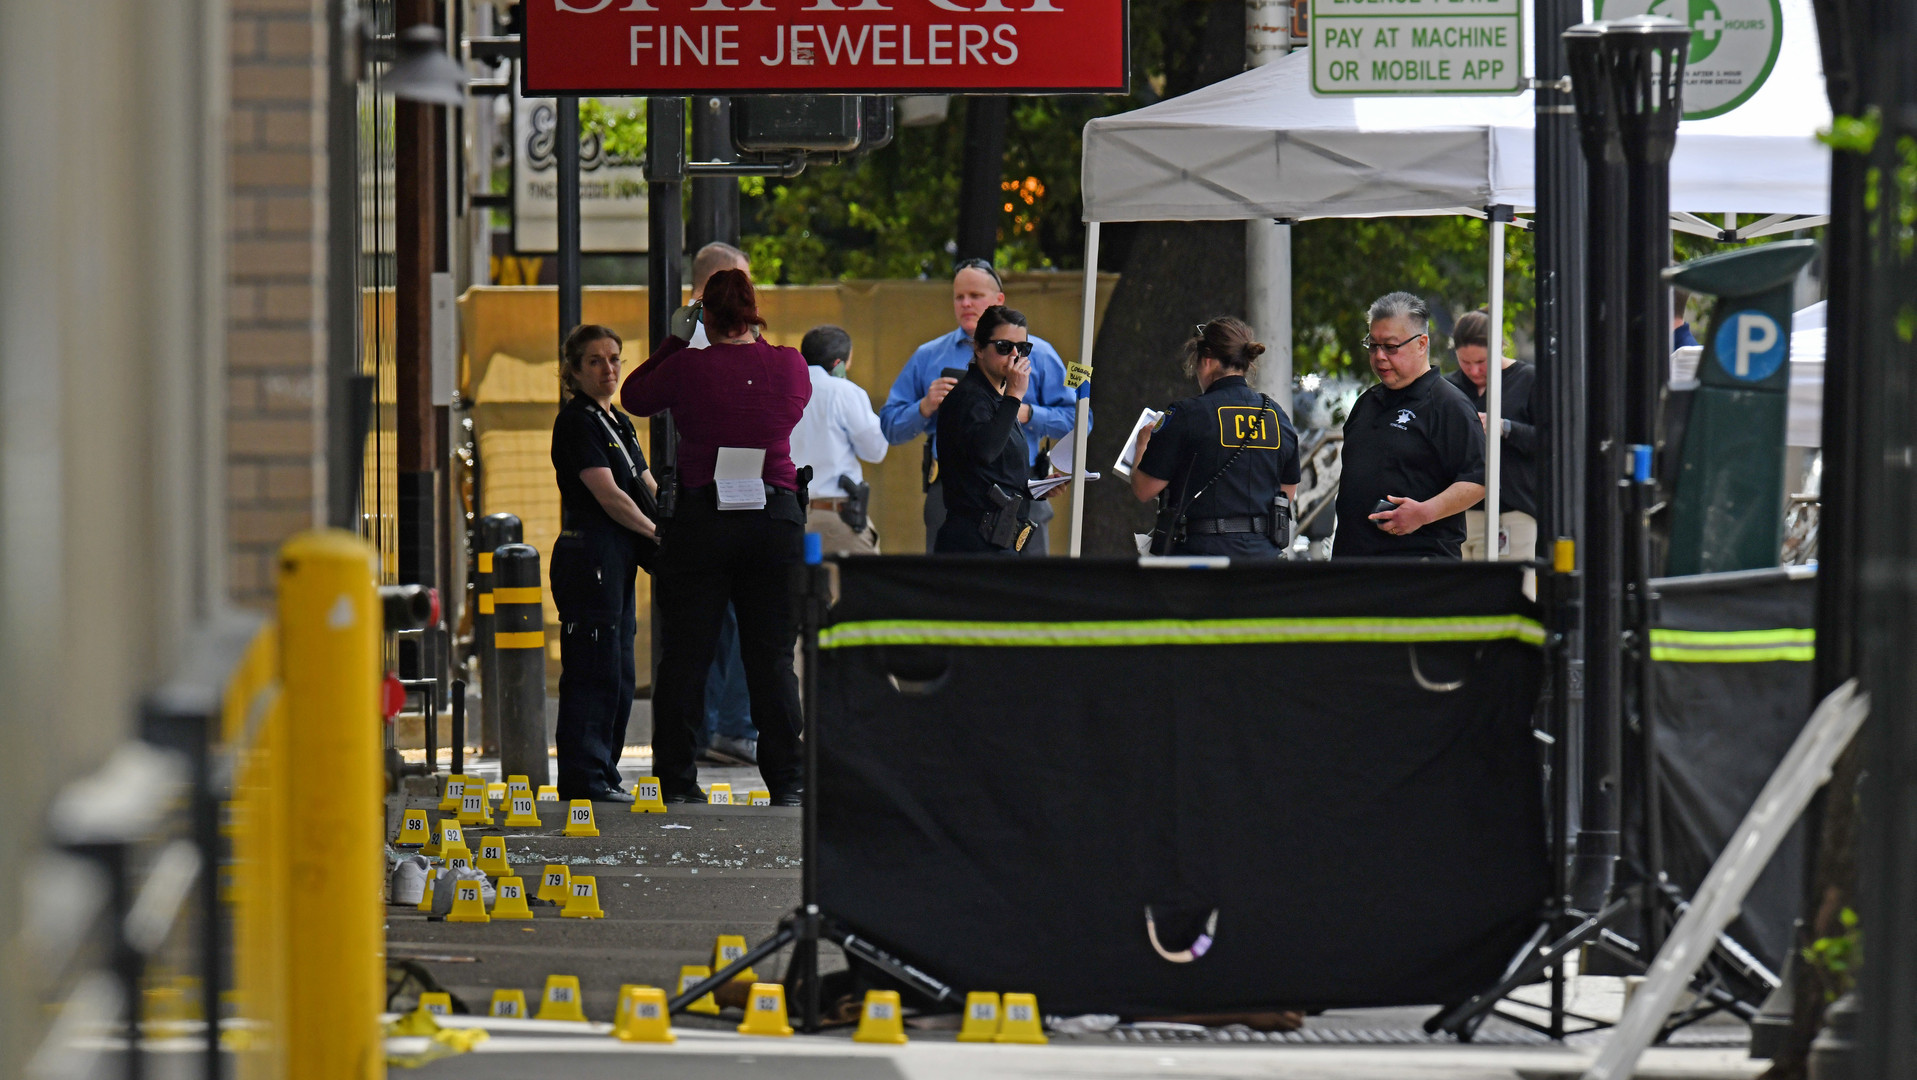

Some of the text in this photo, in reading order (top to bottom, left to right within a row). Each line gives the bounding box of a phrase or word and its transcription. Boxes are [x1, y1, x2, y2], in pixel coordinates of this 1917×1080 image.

[1724, 19, 1766, 30] HOURS
[1325, 26, 1508, 48] PAY AT MACHINE
[630, 24, 1019, 66] FINE JEWELERS
[1329, 59, 1505, 82] OR MOBILE APP
[1735, 314, 1778, 376] P
[1234, 414, 1267, 440] CSI
[640, 786, 657, 797] 115
[464, 798, 480, 809] 111
[712, 794, 727, 803] 136
[514, 801, 531, 811] 110
[572, 810, 589, 820] 109
[408, 819, 421, 830] 98
[432, 833, 440, 845] 92
[447, 830, 458, 841] 92
[485, 847, 497, 859] 81
[452, 859, 465, 869] 80
[549, 874, 561, 886] 79
[462, 889, 475, 901] 75
[505, 886, 517, 898] 76
[576, 885, 589, 897] 77
